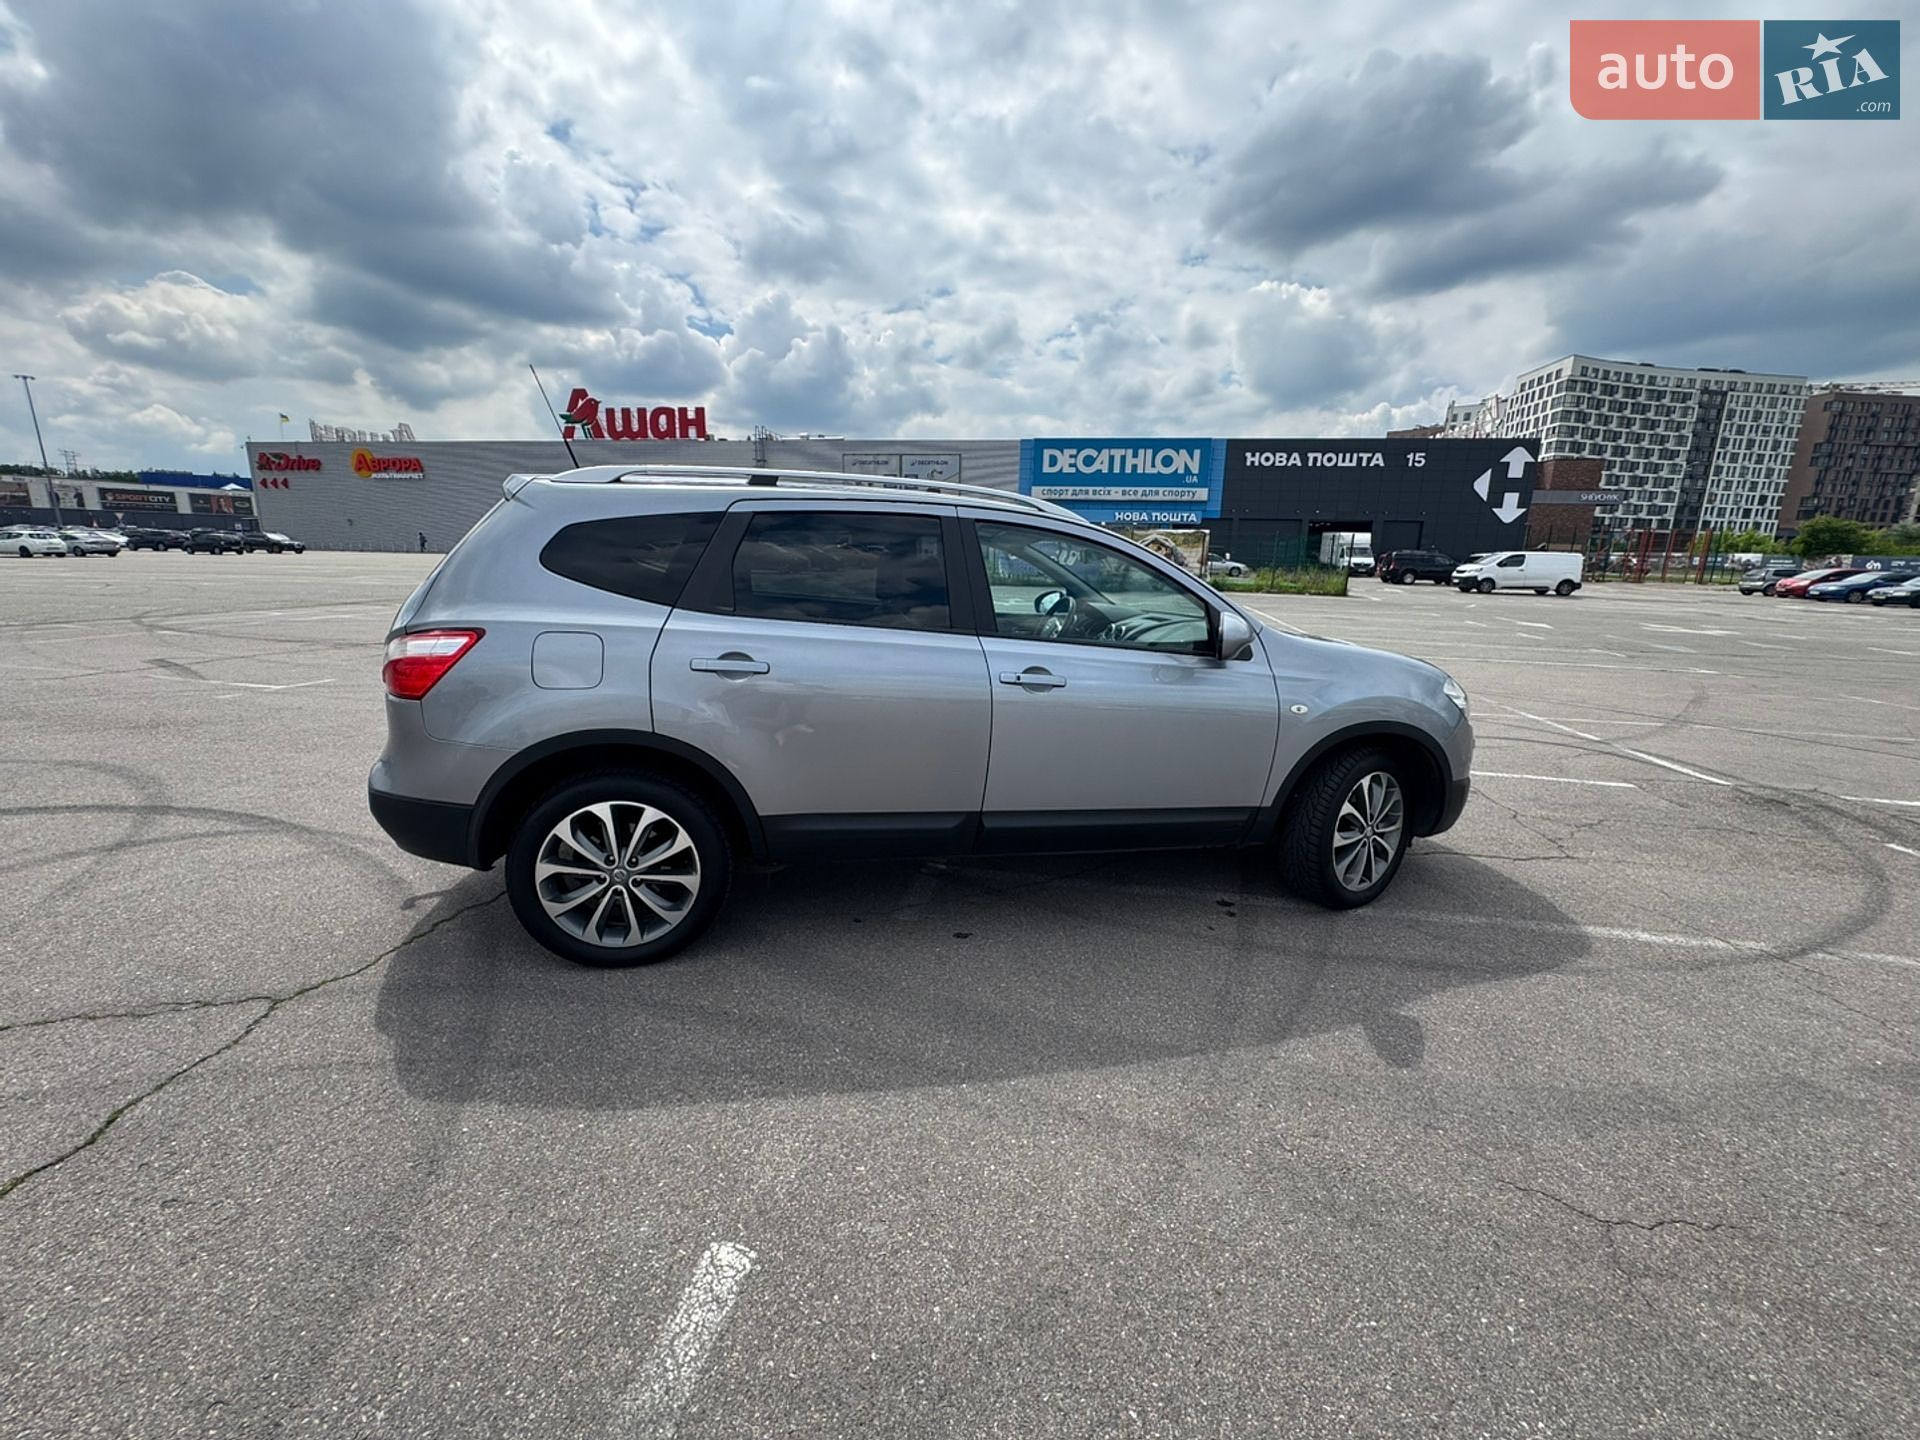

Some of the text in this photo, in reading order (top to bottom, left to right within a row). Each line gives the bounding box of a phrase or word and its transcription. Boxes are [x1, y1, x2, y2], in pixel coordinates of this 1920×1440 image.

[1042, 448, 1201, 474] DECATHLON
[1245, 452, 1426, 467] НОВА ПОШТА 15
[1041, 488, 1069, 497] спорт
[1071, 488, 1090, 497] для
[1092, 487, 1112, 496] всіх
[1121, 489, 1139, 497] все
[1141, 489, 1160, 498] для
[1162, 489, 1198, 499] спорту
[1115, 511, 1198, 523] НОВА ПОШТА
